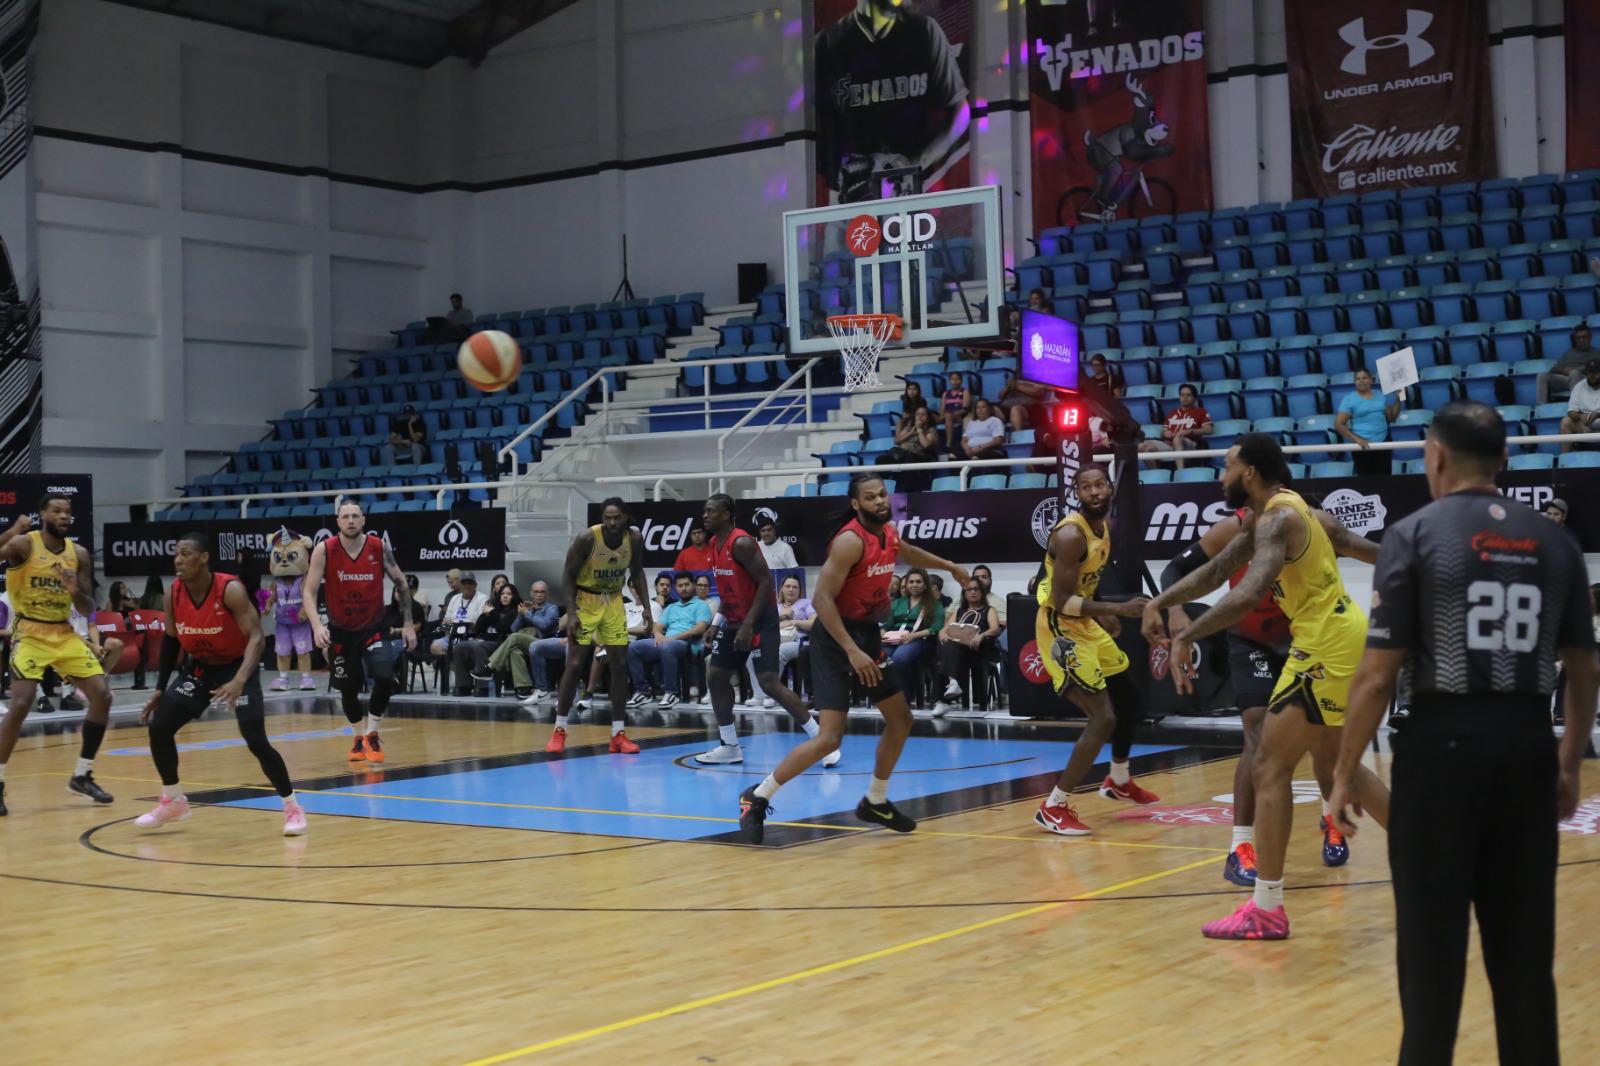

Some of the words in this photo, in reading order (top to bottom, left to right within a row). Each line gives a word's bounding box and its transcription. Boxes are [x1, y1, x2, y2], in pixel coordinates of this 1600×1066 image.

[1036, 31, 1205, 91] VENADOS
[1324, 83, 1379, 101] UNDER
[1384, 71, 1454, 92] ARMOUR
[1321, 123, 1461, 174] Caliente
[1357, 160, 1457, 187] caliente.mx
[882, 212, 937, 244] CID
[888, 242, 934, 253] MAATLAN
[1063, 408, 1079, 426] 13
[420, 548, 451, 560] Banco
[451, 546, 488, 559] Azteca
[1466, 580, 1542, 653] 28
